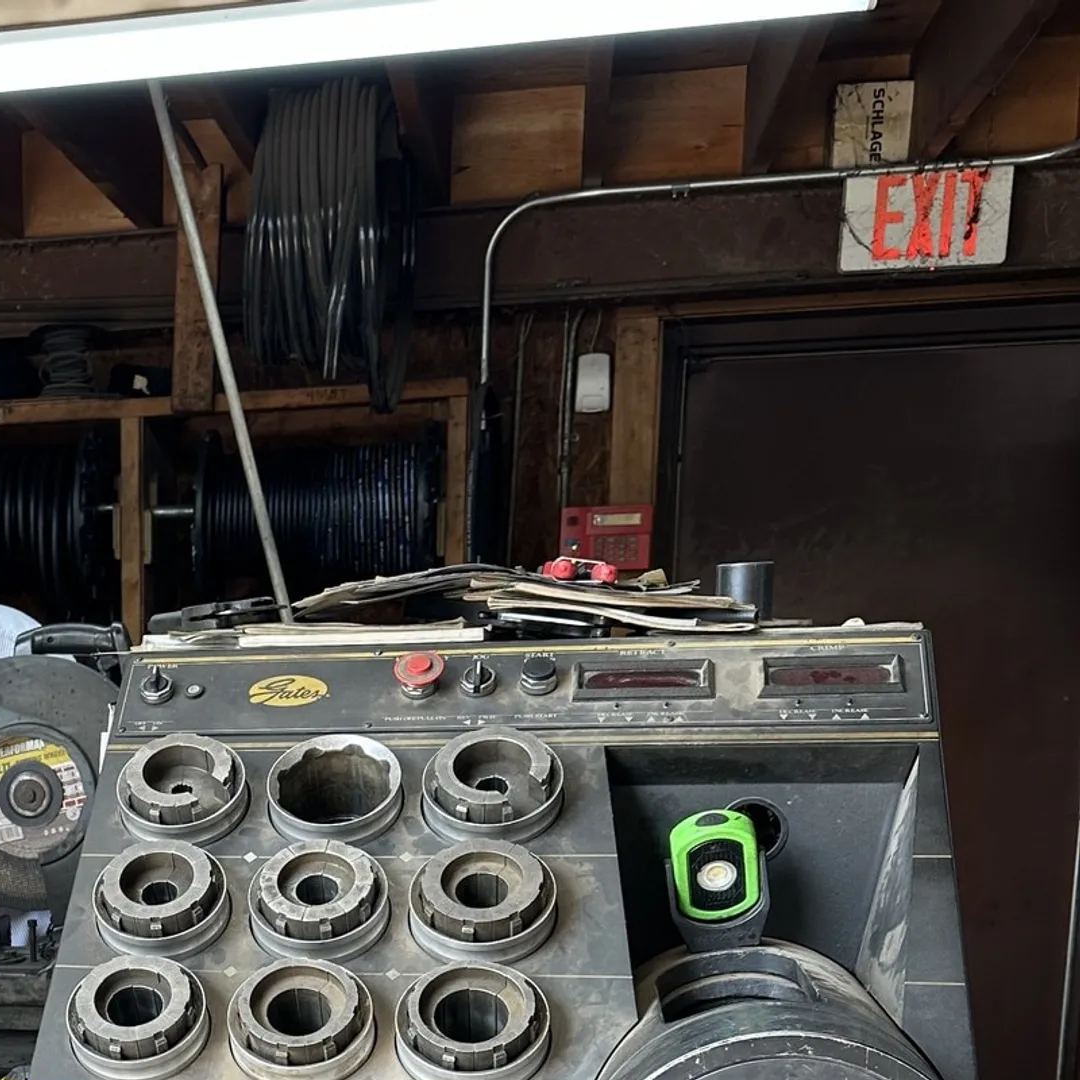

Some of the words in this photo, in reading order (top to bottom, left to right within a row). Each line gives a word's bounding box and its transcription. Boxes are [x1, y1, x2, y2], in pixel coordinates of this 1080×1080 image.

[870, 88, 886, 163] SCHLAGE
[871, 167, 992, 260] EXIT
[525, 652, 555, 660] START
[249, 677, 322, 705] Gates
